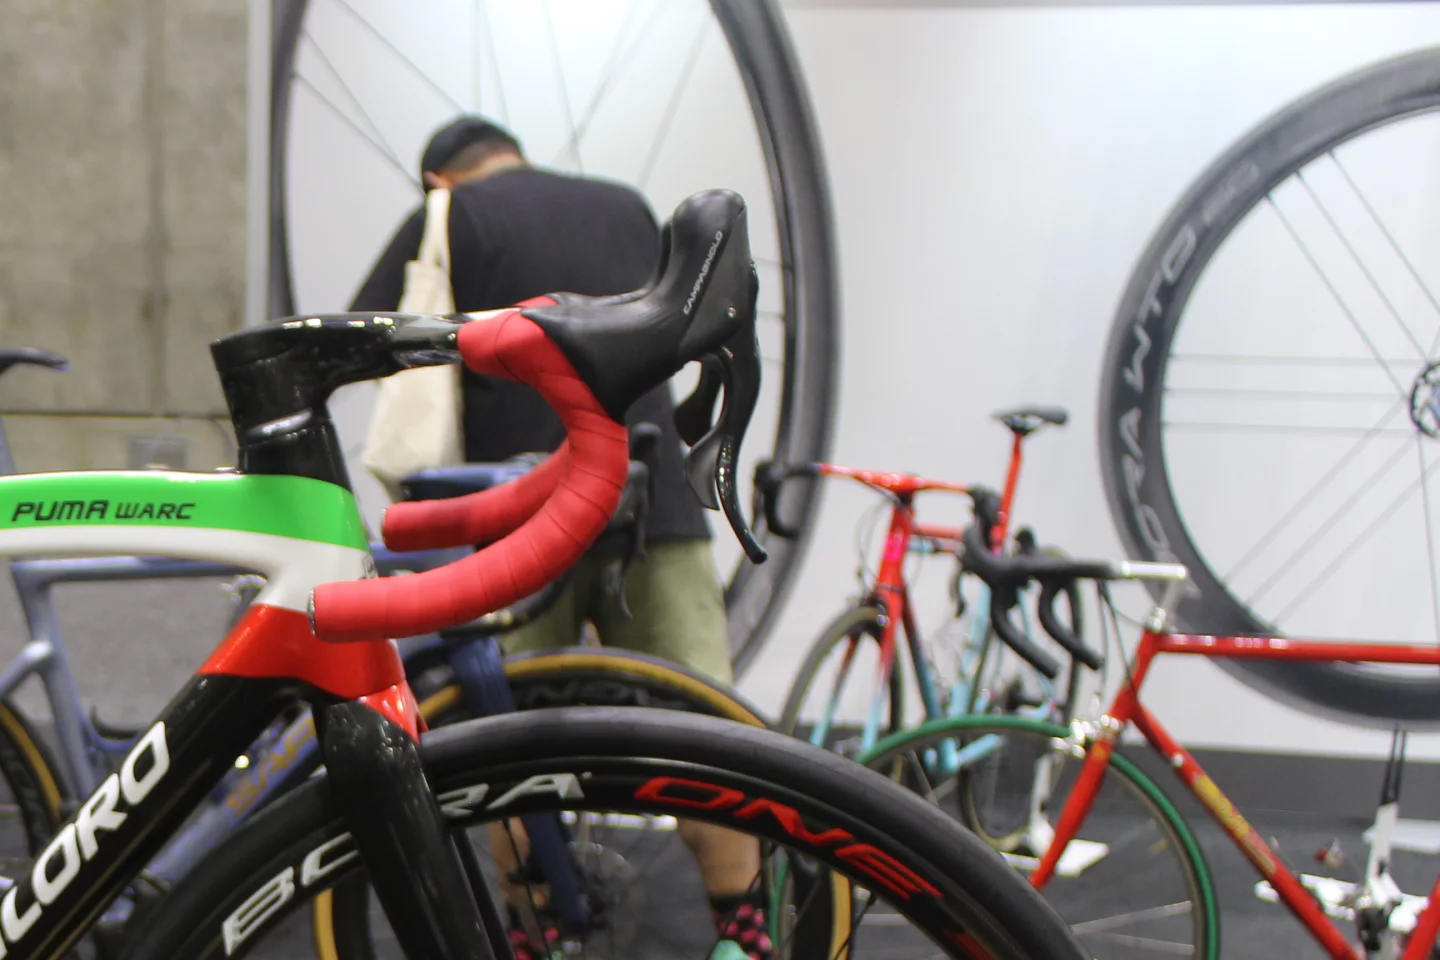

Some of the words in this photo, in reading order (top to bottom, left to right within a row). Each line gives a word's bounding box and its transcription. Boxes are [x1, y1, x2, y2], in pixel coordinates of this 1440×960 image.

[683, 230, 723, 315] CAMPAGNOLO
[1125, 223, 1197, 393] WTO
[11, 499, 109, 522] PUMA
[115, 502, 196, 520] WARC
[635, 777, 944, 900] ONE
